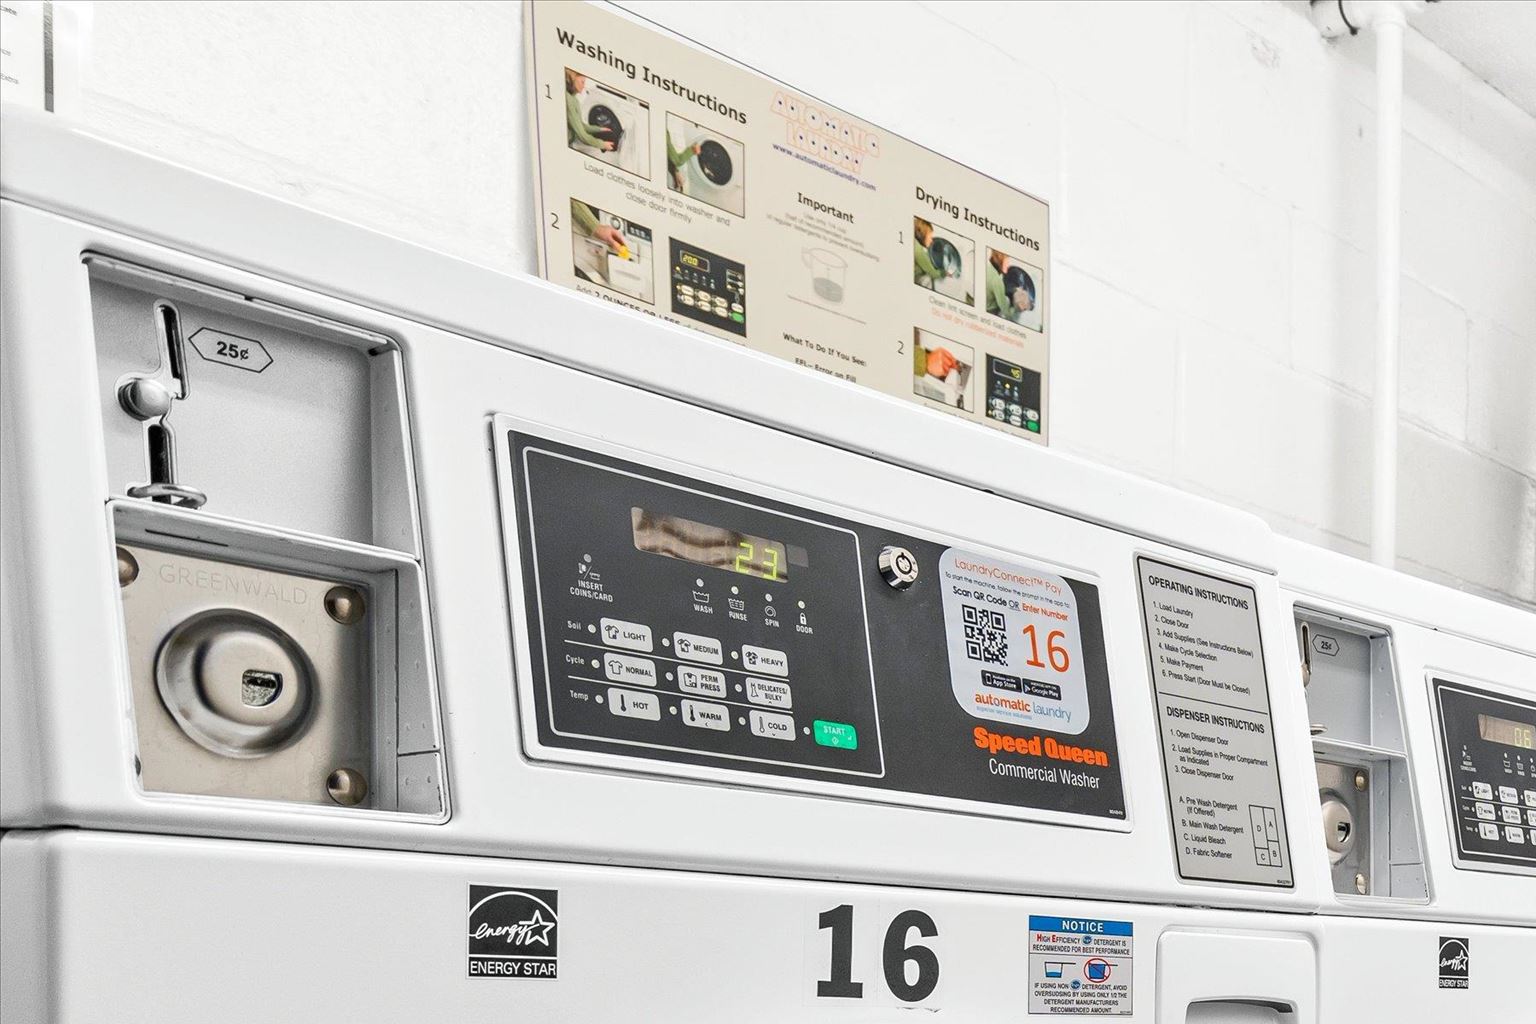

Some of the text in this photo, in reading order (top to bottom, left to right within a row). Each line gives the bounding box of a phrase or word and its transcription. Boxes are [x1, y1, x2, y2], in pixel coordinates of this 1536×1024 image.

[556, 27, 747, 124] Washing Instructions
[545, 83, 552, 100] 1
[584, 161, 730, 226] Load clothes washer and
[797, 192, 854, 224] Important
[550, 212, 560, 229] 2
[916, 186, 1040, 251] Drying Instructions
[899, 231, 904, 245] 1
[216, 340, 250, 361] 25¢
[783, 332, 849, 361] What You
[898, 340, 904, 355] 2
[736, 542, 778, 581] 23
[159, 562, 308, 606] GREENWALD
[578, 580, 603, 591] INSERT
[1046, 581, 1061, 596] Pay
[570, 587, 613, 602] COINS/CARD
[1148, 575, 1248, 610] OPERATING INSTRUCTIONS
[693, 604, 713, 614] WASH
[953, 586, 1068, 621] Scan QR Code Enter Number
[1160, 602, 1193, 618] Load Laundry
[729, 611, 747, 621] RINSE
[764, 618, 779, 628] SPIN
[1161, 616, 1189, 629] Close Door
[567, 621, 581, 630] Soil
[796, 625, 813, 634] DOOR
[623, 632, 646, 642] LIGHT
[1163, 630, 1236, 653] Add Supplies Instructions
[693, 644, 719, 655] MEDIUM
[1023, 624, 1070, 673] 16
[1165, 643, 1217, 661] Make Cycle Selection
[566, 655, 585, 665] Cycle
[761, 657, 783, 667] HEAVY
[1166, 657, 1204, 671] Make Payment
[626, 666, 653, 677] NORMAL
[701, 674, 718, 684] PERM
[1168, 671, 1223, 688] Press Start Must
[701, 683, 720, 692] PRESS
[570, 690, 588, 700] Temp
[764, 693, 782, 701] BULKY
[633, 702, 648, 710] HOT
[975, 693, 1071, 723] automatic laundry
[699, 712, 722, 721] WARM
[1167, 706, 1265, 734] DISPENSER INSTRUCTIONS
[768, 722, 787, 731] COLD
[823, 726, 845, 735] START
[1176, 730, 1228, 746] Open Dispenser Door
[973, 727, 1109, 767] Speed Queen
[1178, 745, 1268, 767] Load Supplies Proper Compartment
[1187, 755, 1209, 766] Indicated
[989, 758, 1100, 789] Commercial Washer
[1181, 766, 1234, 781] Close Dispenser Door
[1197, 798, 1237, 811] Wash Detergent
[1189, 820, 1243, 834] Main Wash Detergent
[1191, 834, 1226, 845] Liquid Bleach
[1193, 848, 1232, 859] Fabric Softener
[1062, 920, 1103, 932] NOTICE
[476, 922, 532, 945] energy
[817, 904, 940, 1003] 16
[1033, 944, 1070, 952] RECOMMENDED
[1095, 947, 1129, 955] PERFORMANCE
[470, 961, 556, 975] ENERGY STAR
[1440, 979, 1468, 988] ENERGY STAR
